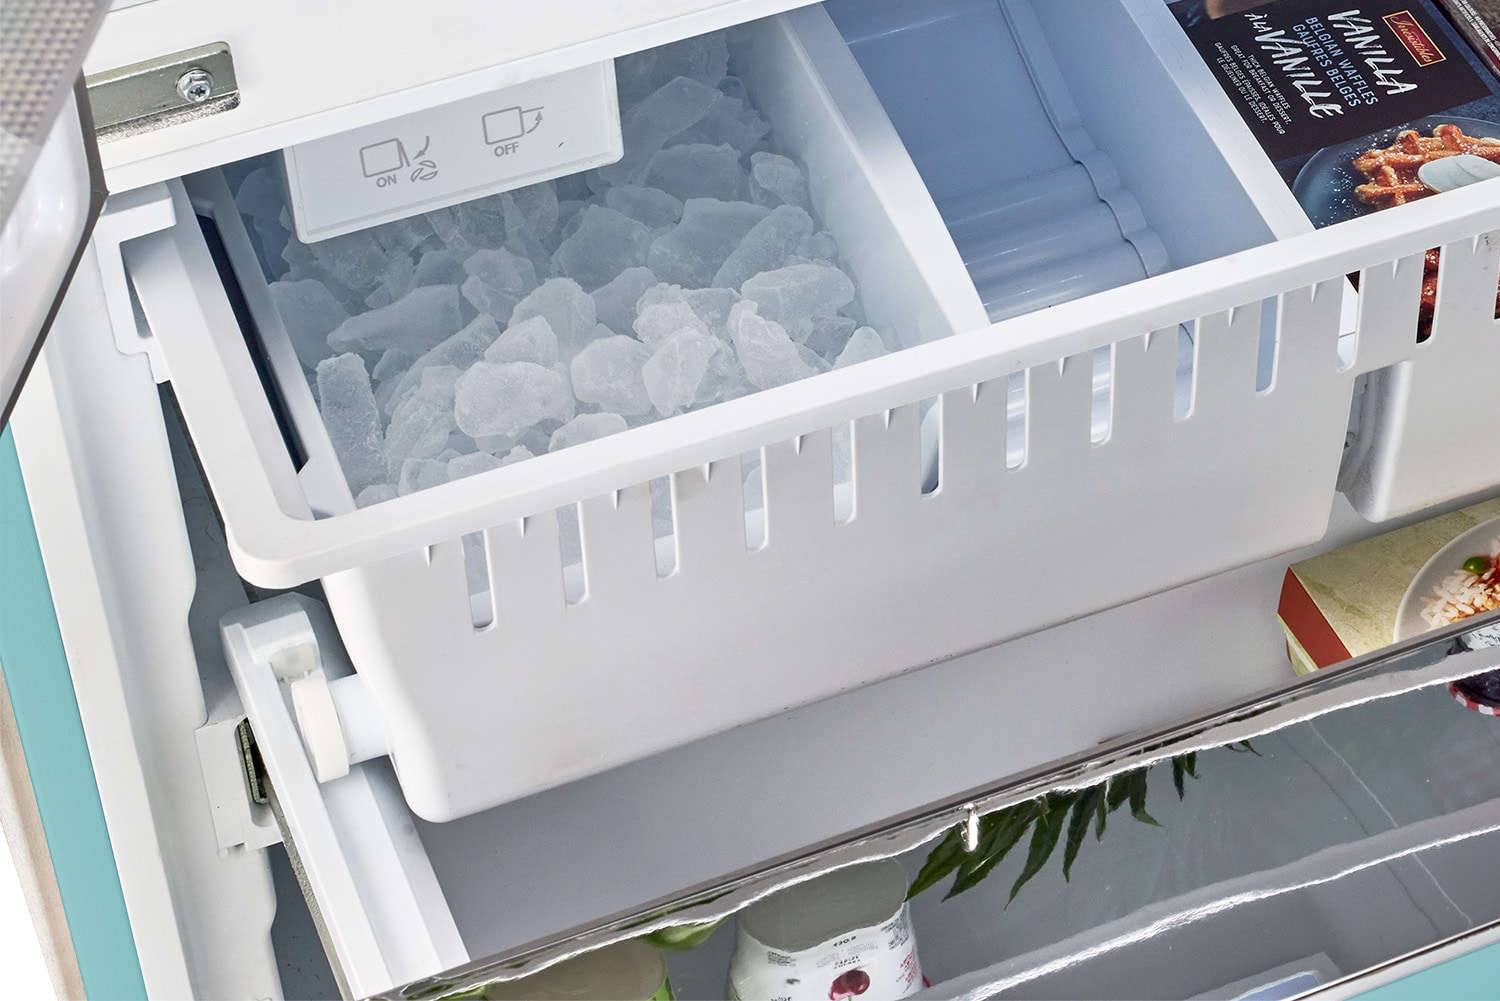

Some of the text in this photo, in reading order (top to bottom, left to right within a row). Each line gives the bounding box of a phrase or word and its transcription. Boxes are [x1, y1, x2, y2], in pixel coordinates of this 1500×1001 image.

[1252, 21, 1273, 32] LA
[1292, 24, 1362, 107] GAUFRES BELGES
[1305, 16, 1379, 106] BELGIAN WAFFLES
[1328, 9, 1418, 95] VANILLA
[1214, 42, 1234, 62] GAUFRES
[1230, 62, 1246, 80] BELGES
[1272, 120, 1286, 134] POUR
[1230, 44, 1292, 124] GREAT FOR BREAKFAST OR DESSERT.
[1238, 86, 1246, 94] OU
[1248, 54, 1291, 110] THICK BELGIAN WAFFLES
[1254, 30, 1344, 118] VANILLE
[376, 174, 398, 188] ON
[494, 141, 520, 157] OFF
